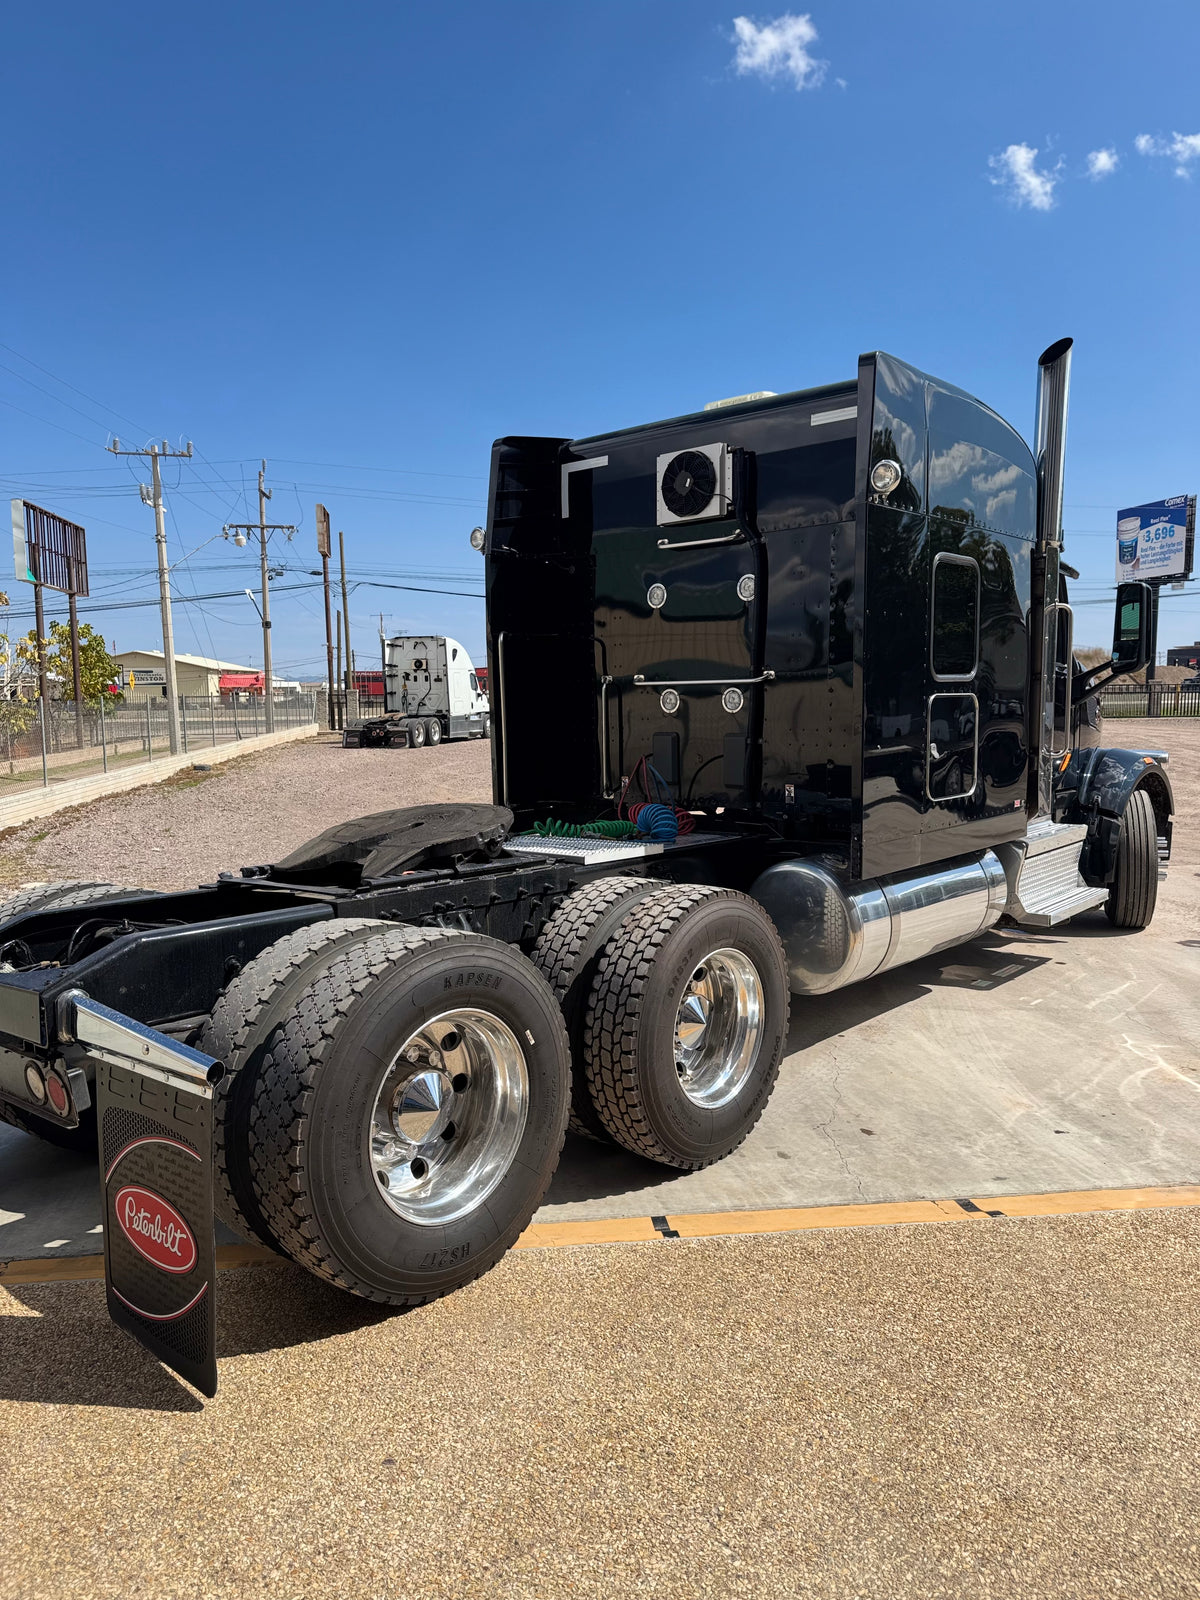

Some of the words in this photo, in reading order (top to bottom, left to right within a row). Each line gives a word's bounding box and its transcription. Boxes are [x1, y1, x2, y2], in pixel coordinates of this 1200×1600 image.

[1164, 495, 1186, 506] Comex
[1142, 525, 1175, 543] $3,696
[443, 972, 503, 990] KAPSEN
[125, 1196, 187, 1256] Peterbilt
[418, 1242, 470, 1269] HS217
